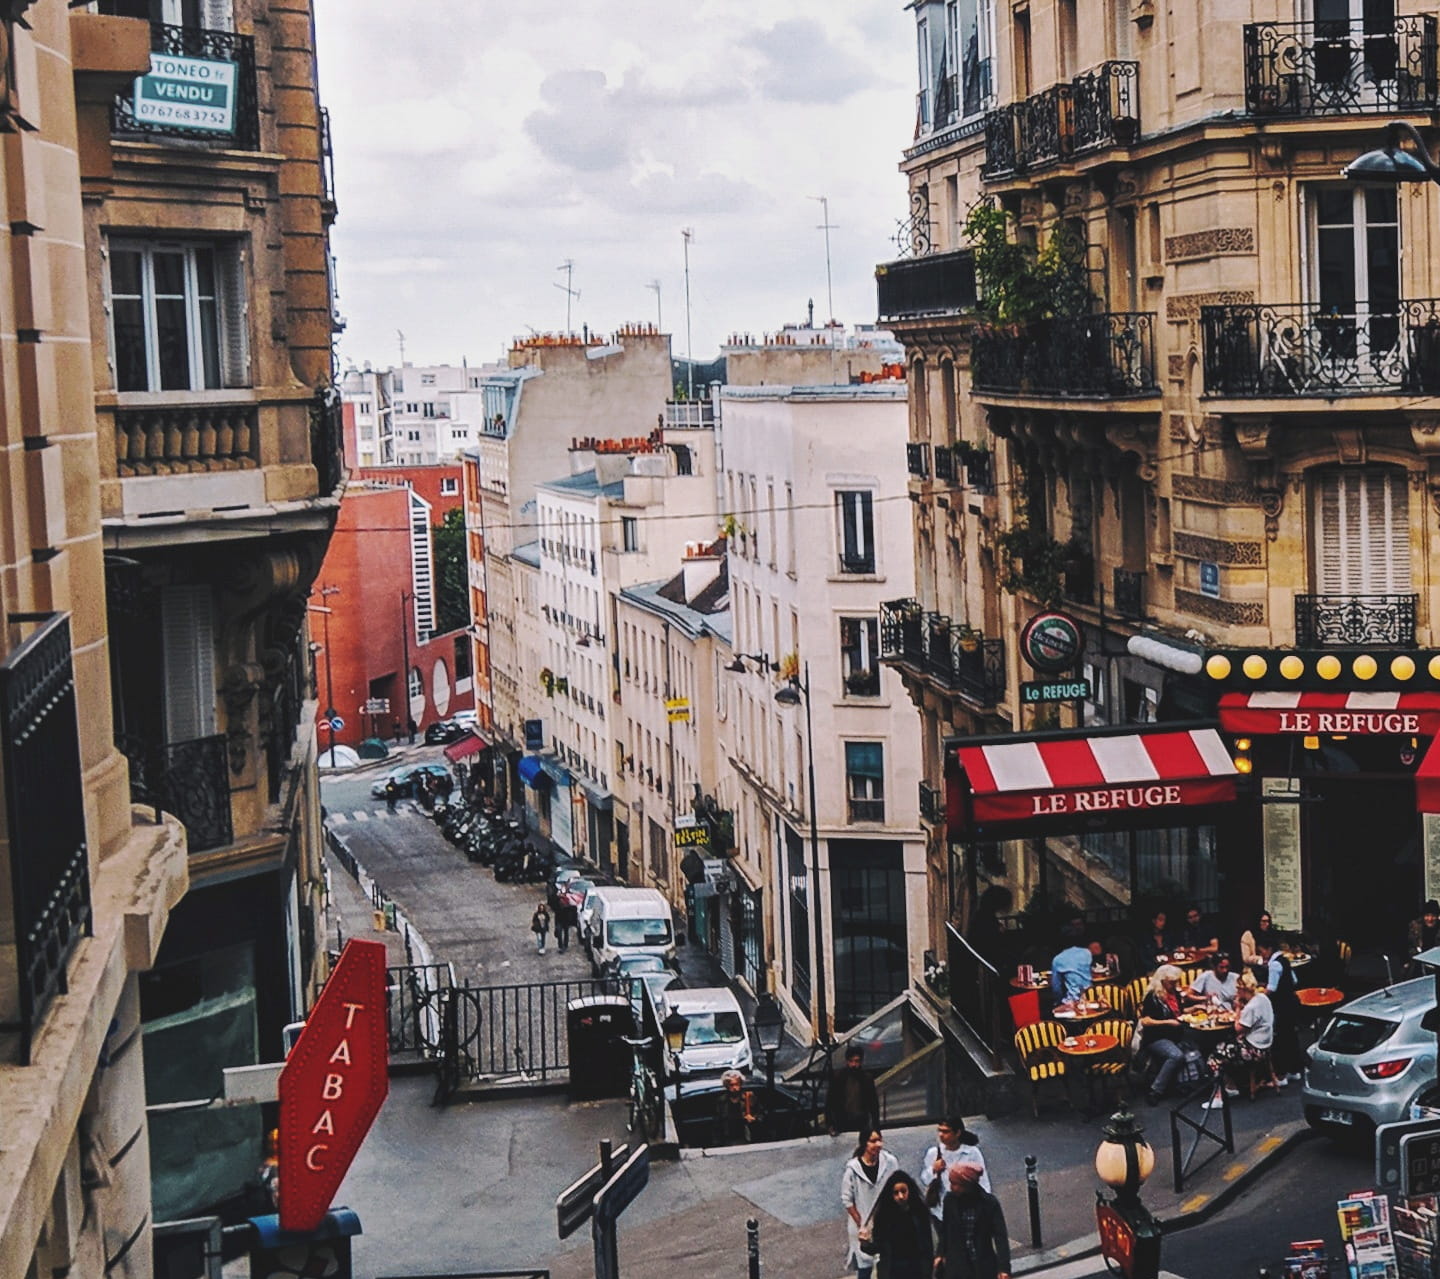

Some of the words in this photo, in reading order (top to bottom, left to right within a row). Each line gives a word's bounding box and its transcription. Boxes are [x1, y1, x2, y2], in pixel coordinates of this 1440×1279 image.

[154, 82, 213, 102] VENDU
[1025, 687, 1040, 700] Le
[1042, 683, 1087, 700] REFUGE
[1279, 712, 1311, 732] LE
[1317, 713, 1420, 734] REFUGE
[1032, 794, 1067, 815] LE
[1075, 786, 1181, 812] REFUGE
[305, 1002, 365, 1173] TABAC
